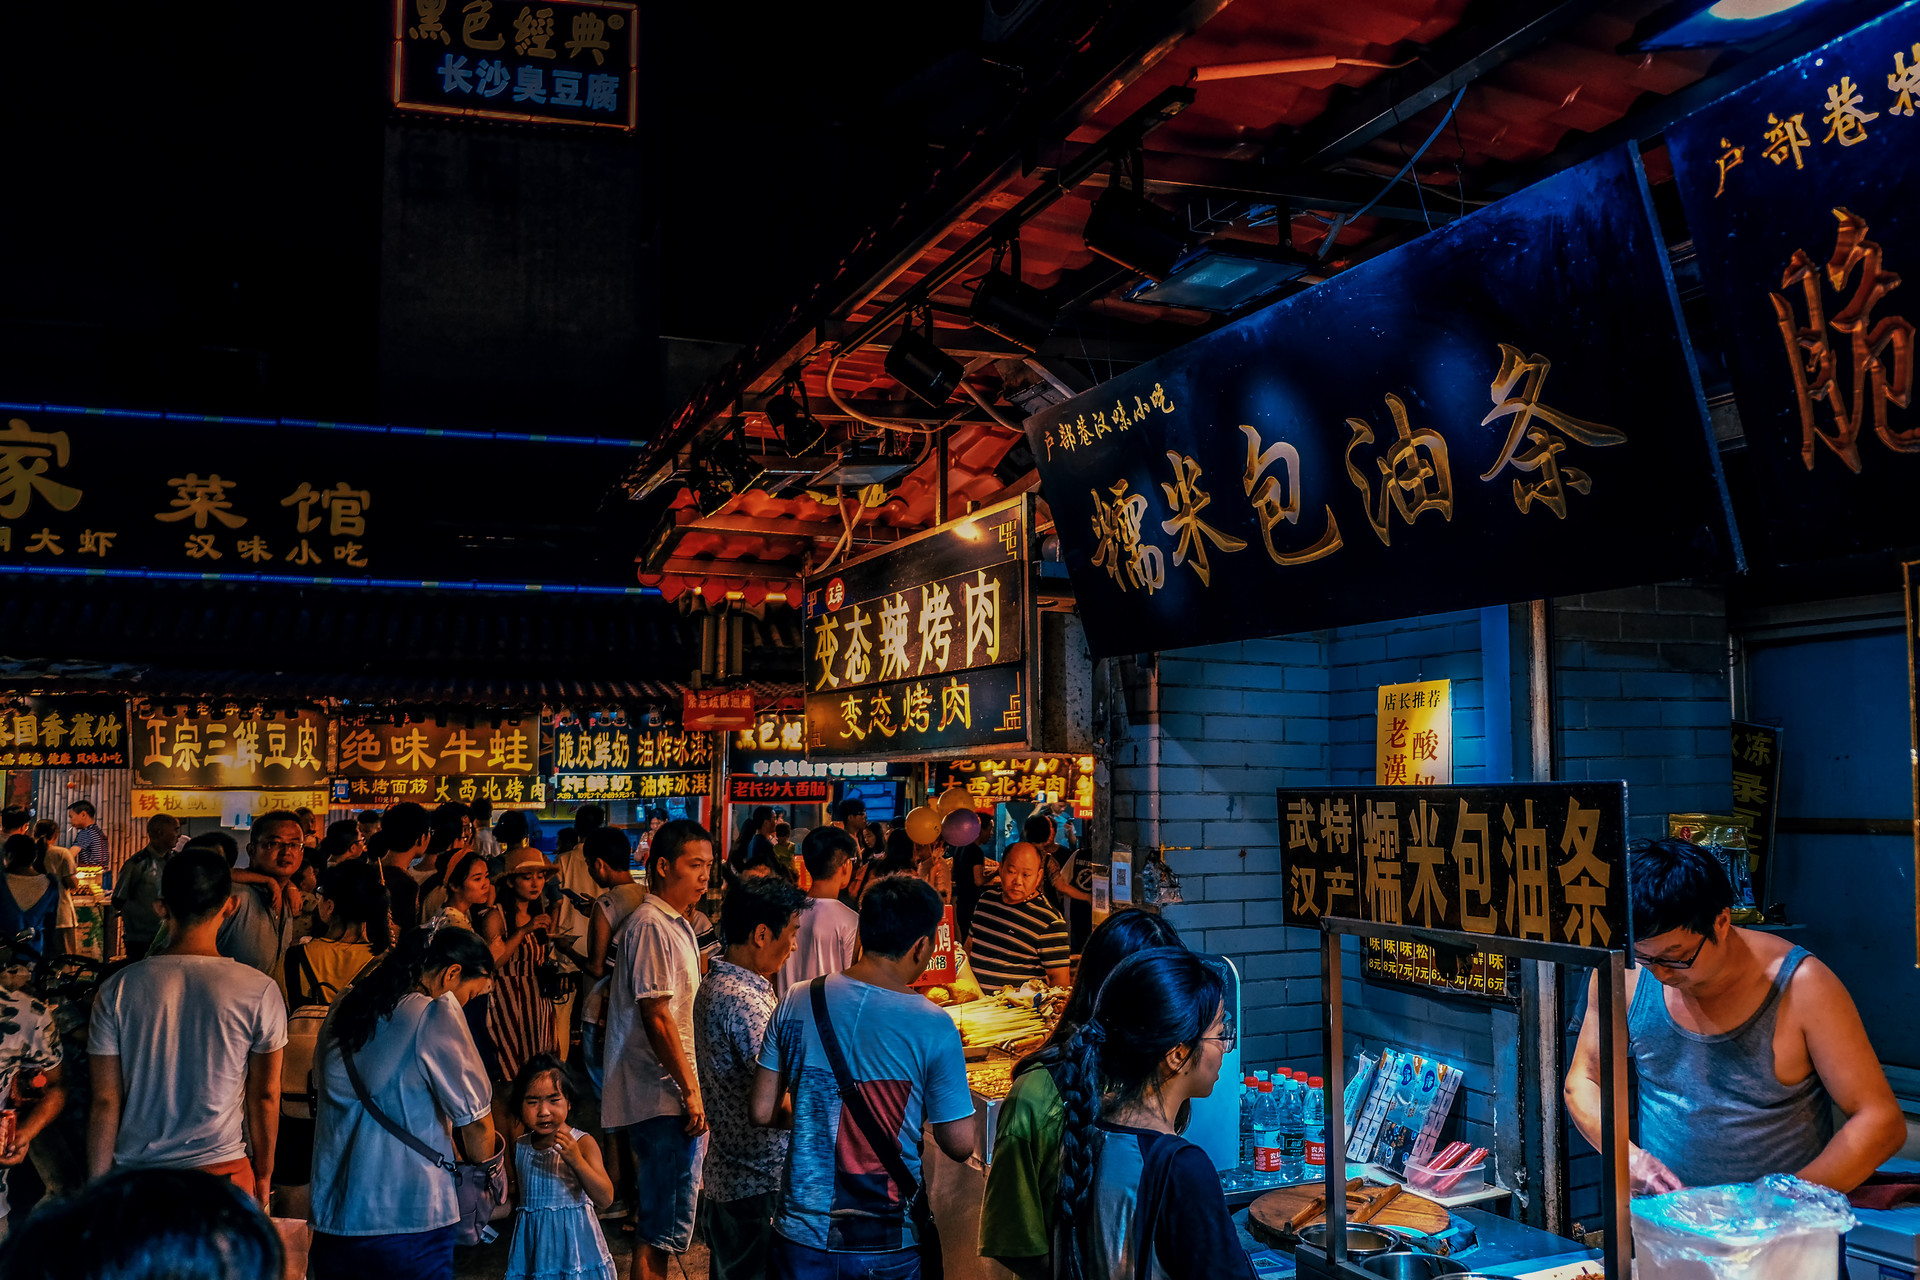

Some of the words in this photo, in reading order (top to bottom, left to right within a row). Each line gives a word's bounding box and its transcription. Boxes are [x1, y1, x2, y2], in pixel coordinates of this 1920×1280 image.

[437, 53, 620, 112] 长沙臭豆腐
[1044, 382, 1175, 463] 户部巷汉味小吃
[1090, 342, 1628, 596] 糯米包油条
[154, 472, 371, 537] 菜馆
[0, 525, 117, 558] 大虾
[184, 533, 368, 568] 汉味小吃
[814, 569, 1001, 692] 变态辣烤肉
[839, 676, 973, 741] 变态烤肉
[1383, 690, 1441, 711] 店长推荐
[143, 717, 322, 774] 正宗三鲜豆皮
[339, 727, 534, 772] 绝味牛蛙
[331, 778, 429, 803] 味烤面筋
[434, 775, 547, 803] 大西北烤肉
[640, 773, 712, 798] 油炸冰淇
[733, 781, 826, 798] 老长沙大香肠
[1361, 796, 1612, 947] 糯米包油条
